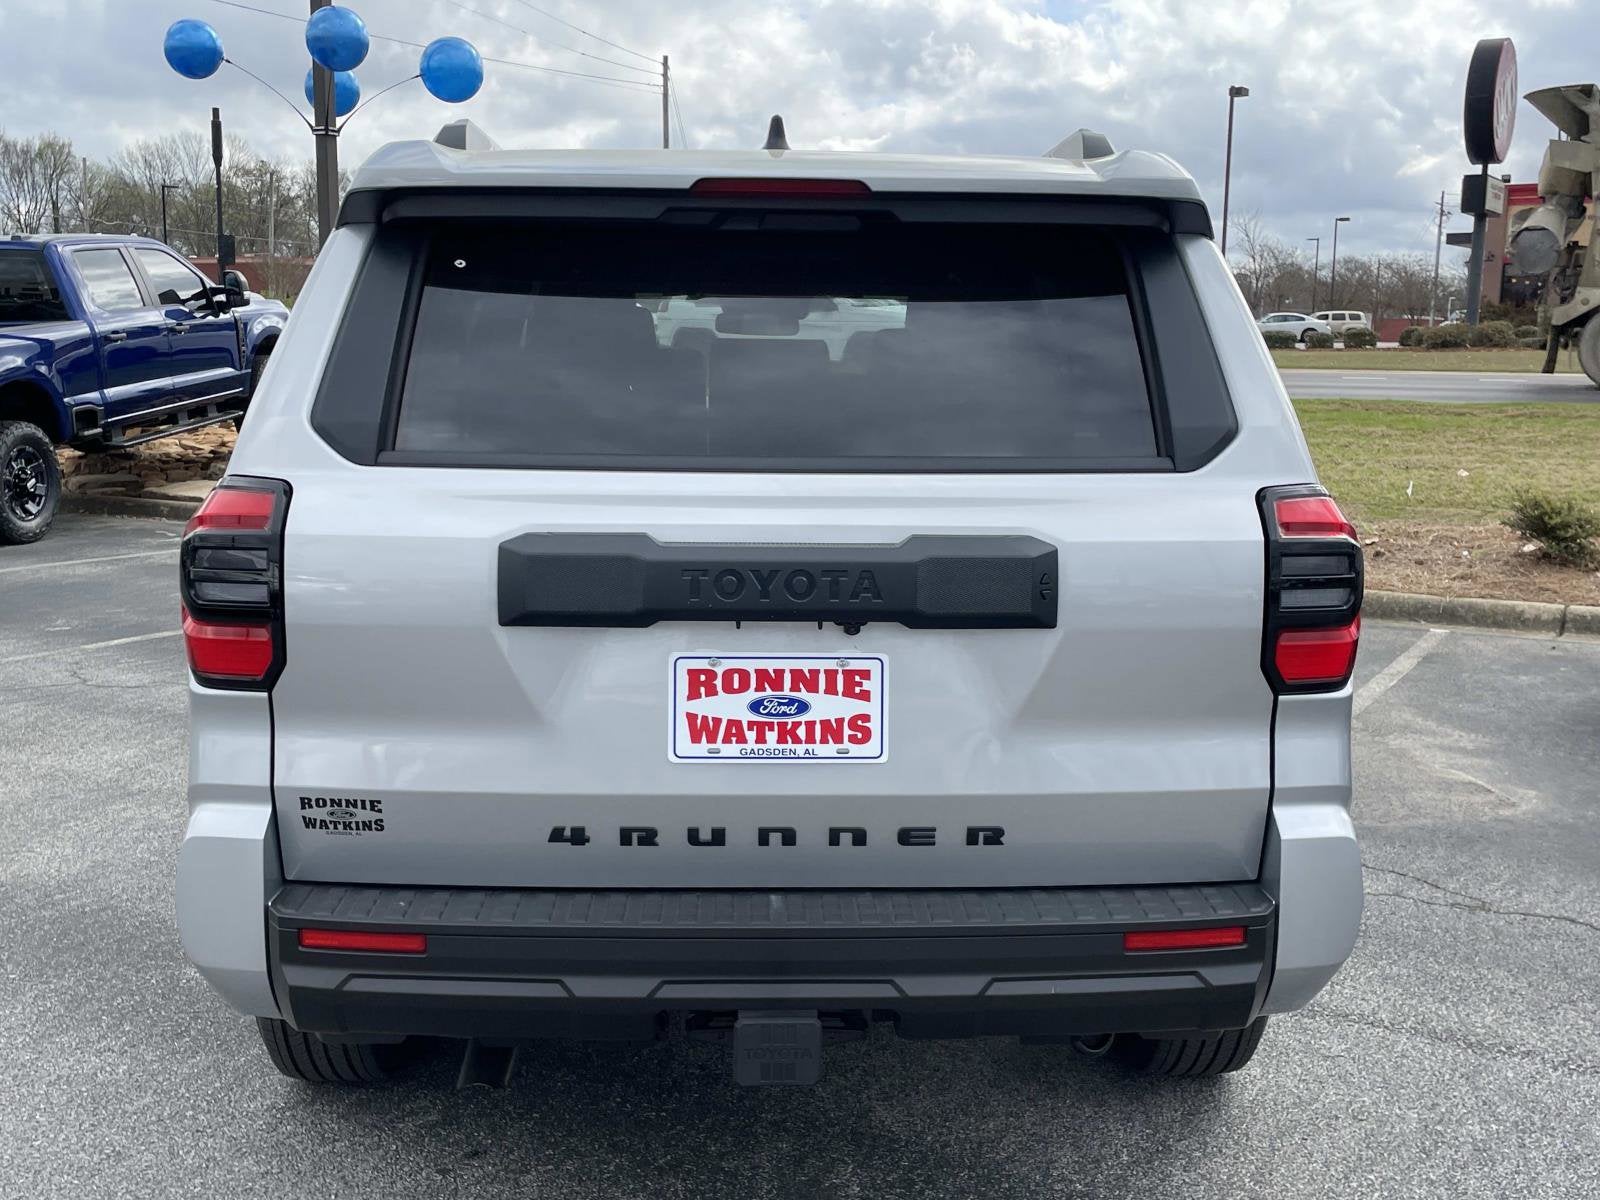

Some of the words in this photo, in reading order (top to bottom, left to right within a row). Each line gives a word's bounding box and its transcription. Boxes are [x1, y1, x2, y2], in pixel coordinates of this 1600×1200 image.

[680, 568, 883, 602] TOYOTA
[686, 668, 871, 702] RONNIE
[759, 696, 798, 715] Ford
[685, 711, 872, 745] WATKINS
[739, 748, 800, 757] GADSDEN,
[803, 748, 818, 756] AL
[299, 796, 383, 813] RONNIE
[301, 815, 385, 832] WATKINS
[547, 825, 1005, 847] 4RUNNER
[743, 1047, 813, 1060] TOYOTA
